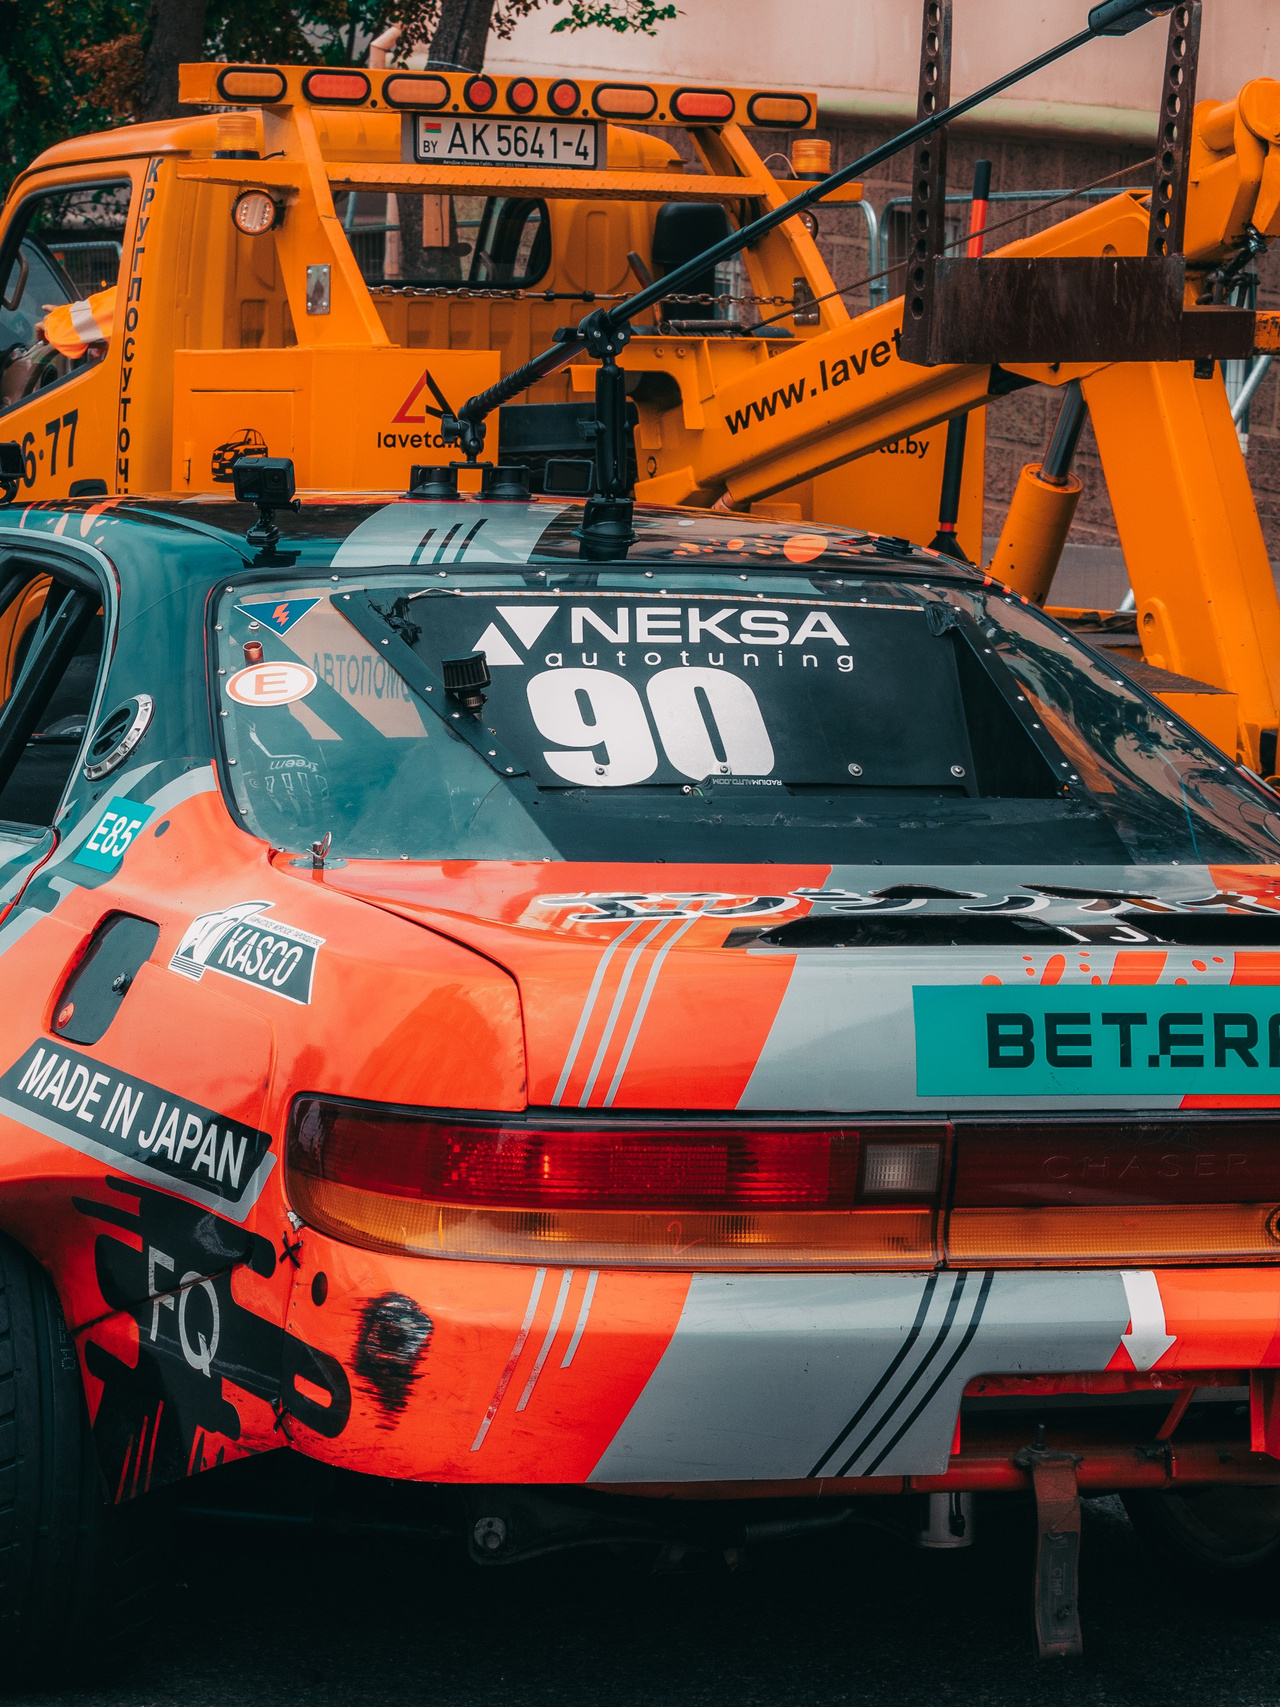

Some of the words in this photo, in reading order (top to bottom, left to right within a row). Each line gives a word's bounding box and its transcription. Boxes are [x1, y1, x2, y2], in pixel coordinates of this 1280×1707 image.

[422, 140, 438, 153] BY
[571, 606, 850, 646] NEKSA
[544, 650, 854, 673] autotuning
[526, 666, 775, 787] 90
[85, 811, 143, 858] E85
[218, 925, 304, 987] KASCO
[17, 1047, 110, 1123] MADE
[100, 1082, 144, 1139] IN
[138, 1101, 248, 1189] JAPAN
[1042, 1153, 1253, 1179] CHASER
[148, 1245, 220, 1378] FQ
